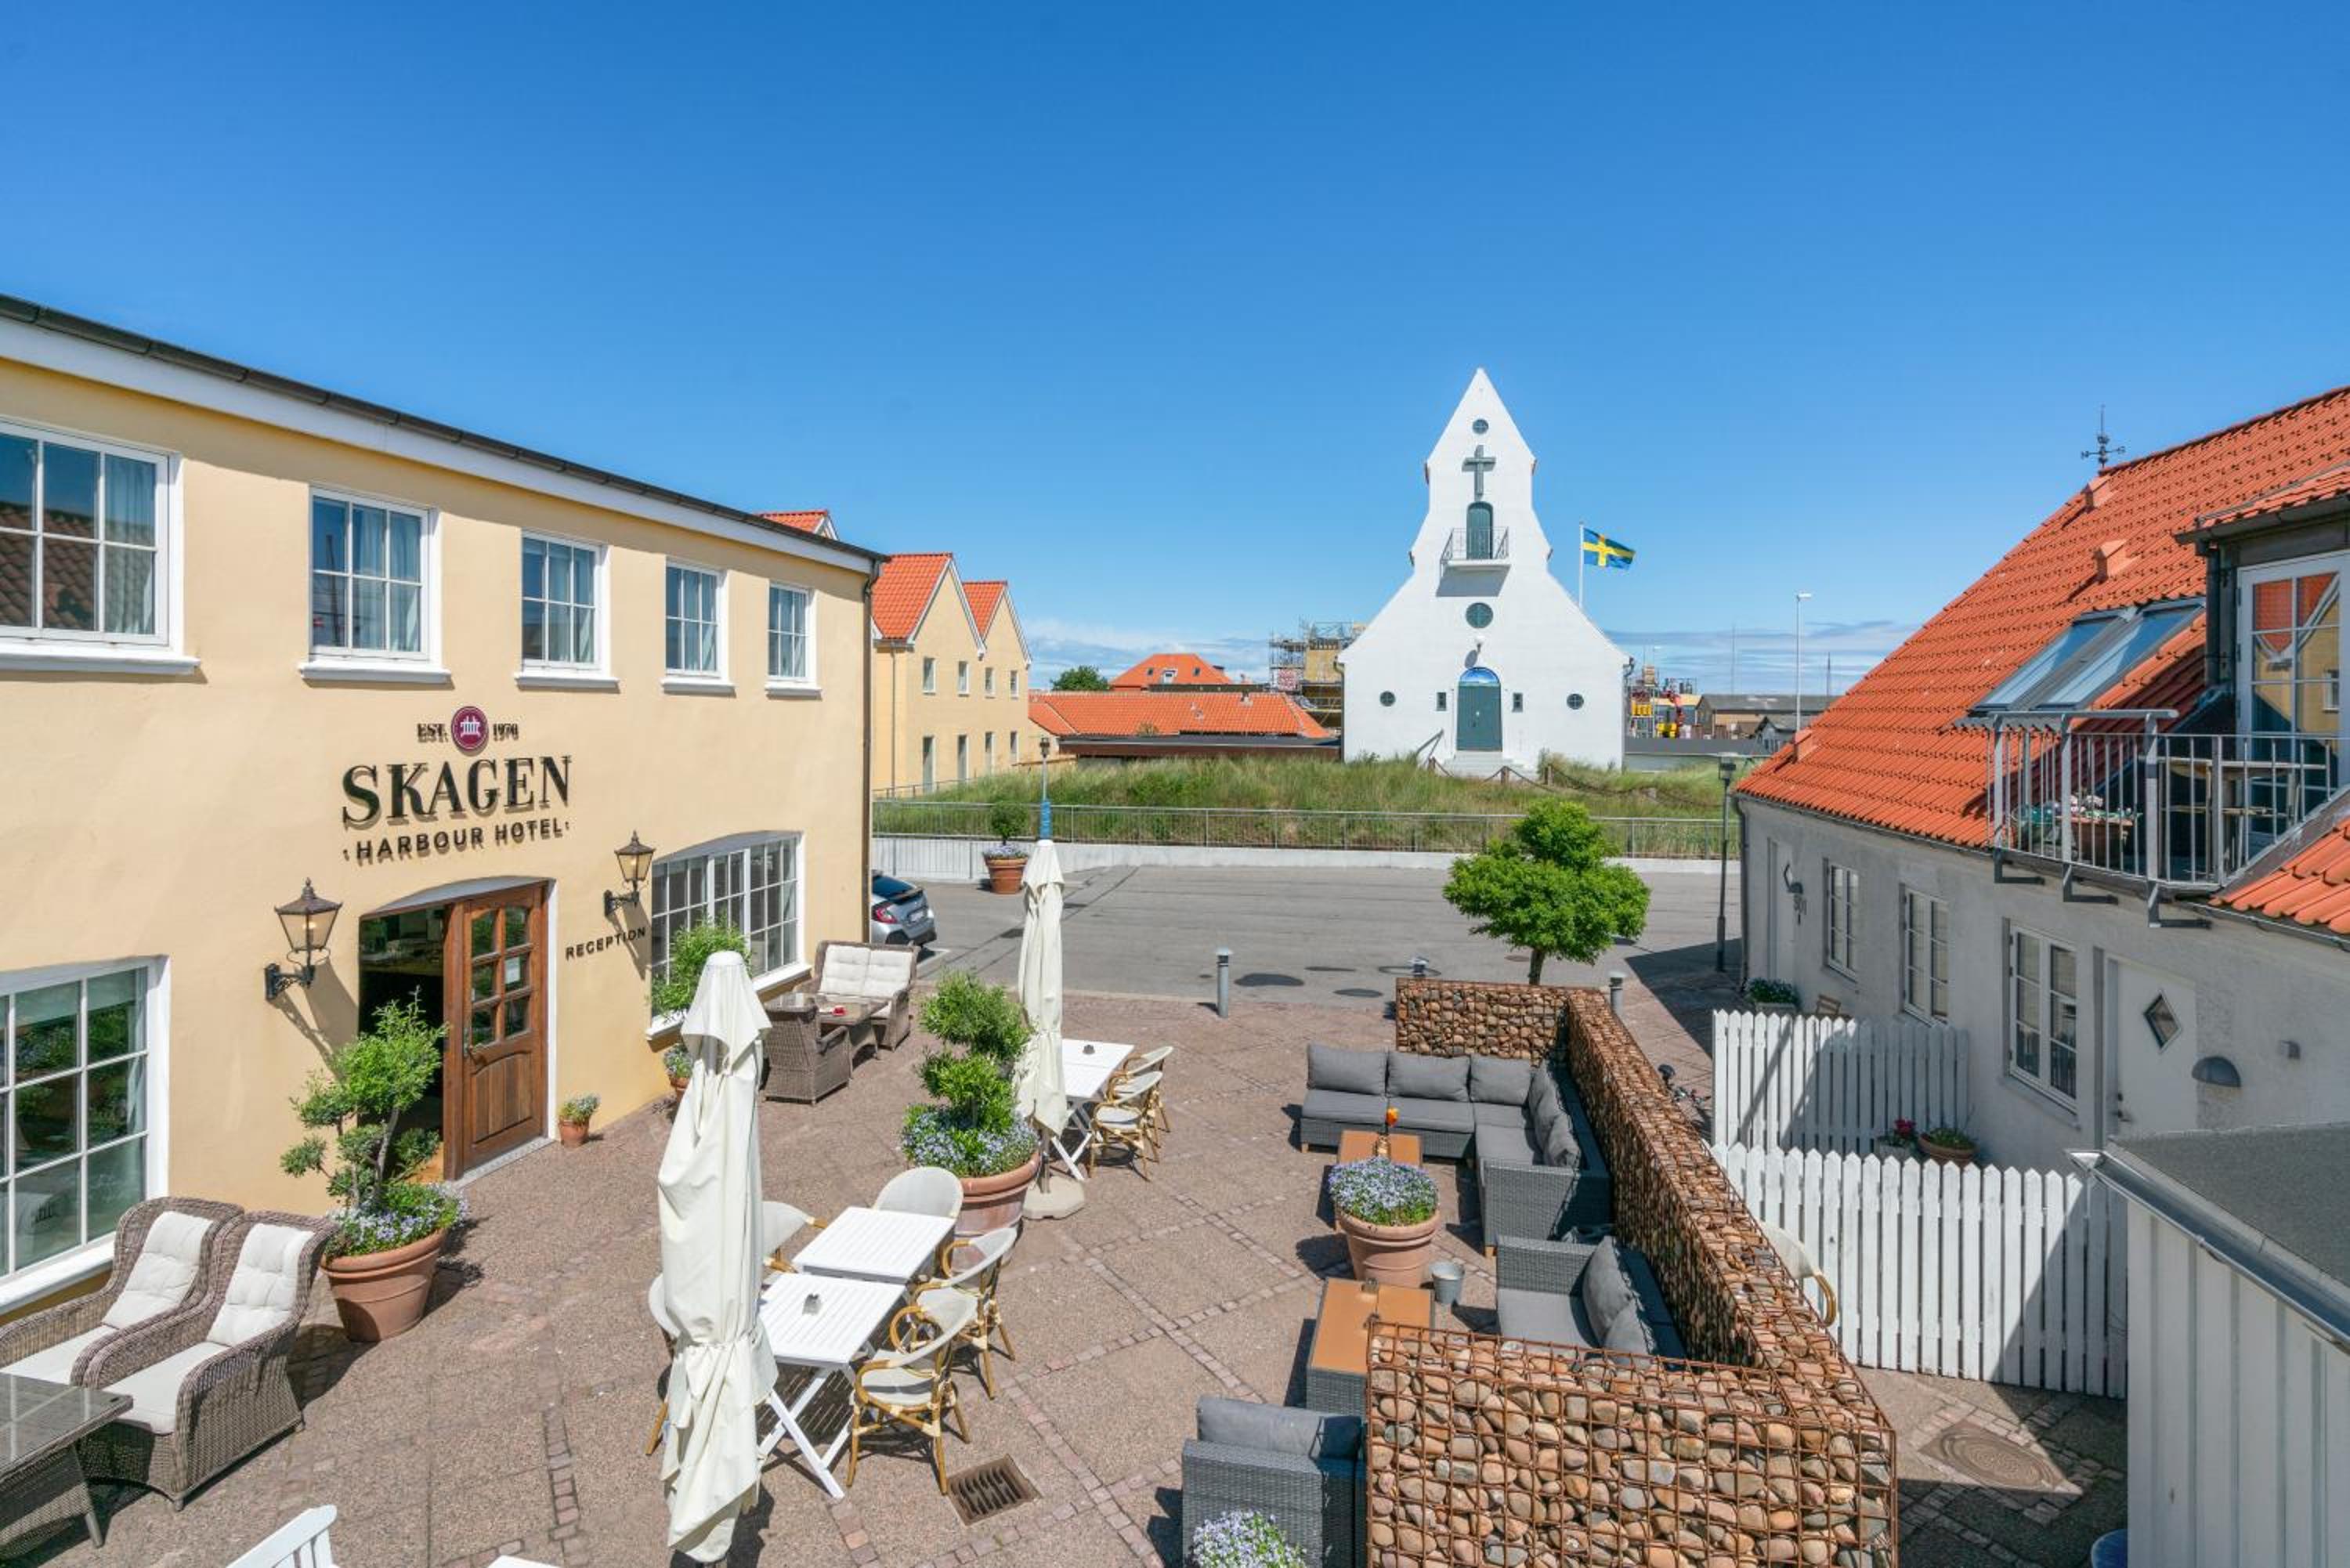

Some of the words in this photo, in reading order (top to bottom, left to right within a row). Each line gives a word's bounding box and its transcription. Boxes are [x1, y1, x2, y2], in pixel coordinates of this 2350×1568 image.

[342, 755, 570, 824] SKAGEN
[356, 827, 484, 861] HARBOUR
[494, 818, 563, 841] HOTEL
[566, 927, 646, 960] RECEPTION
